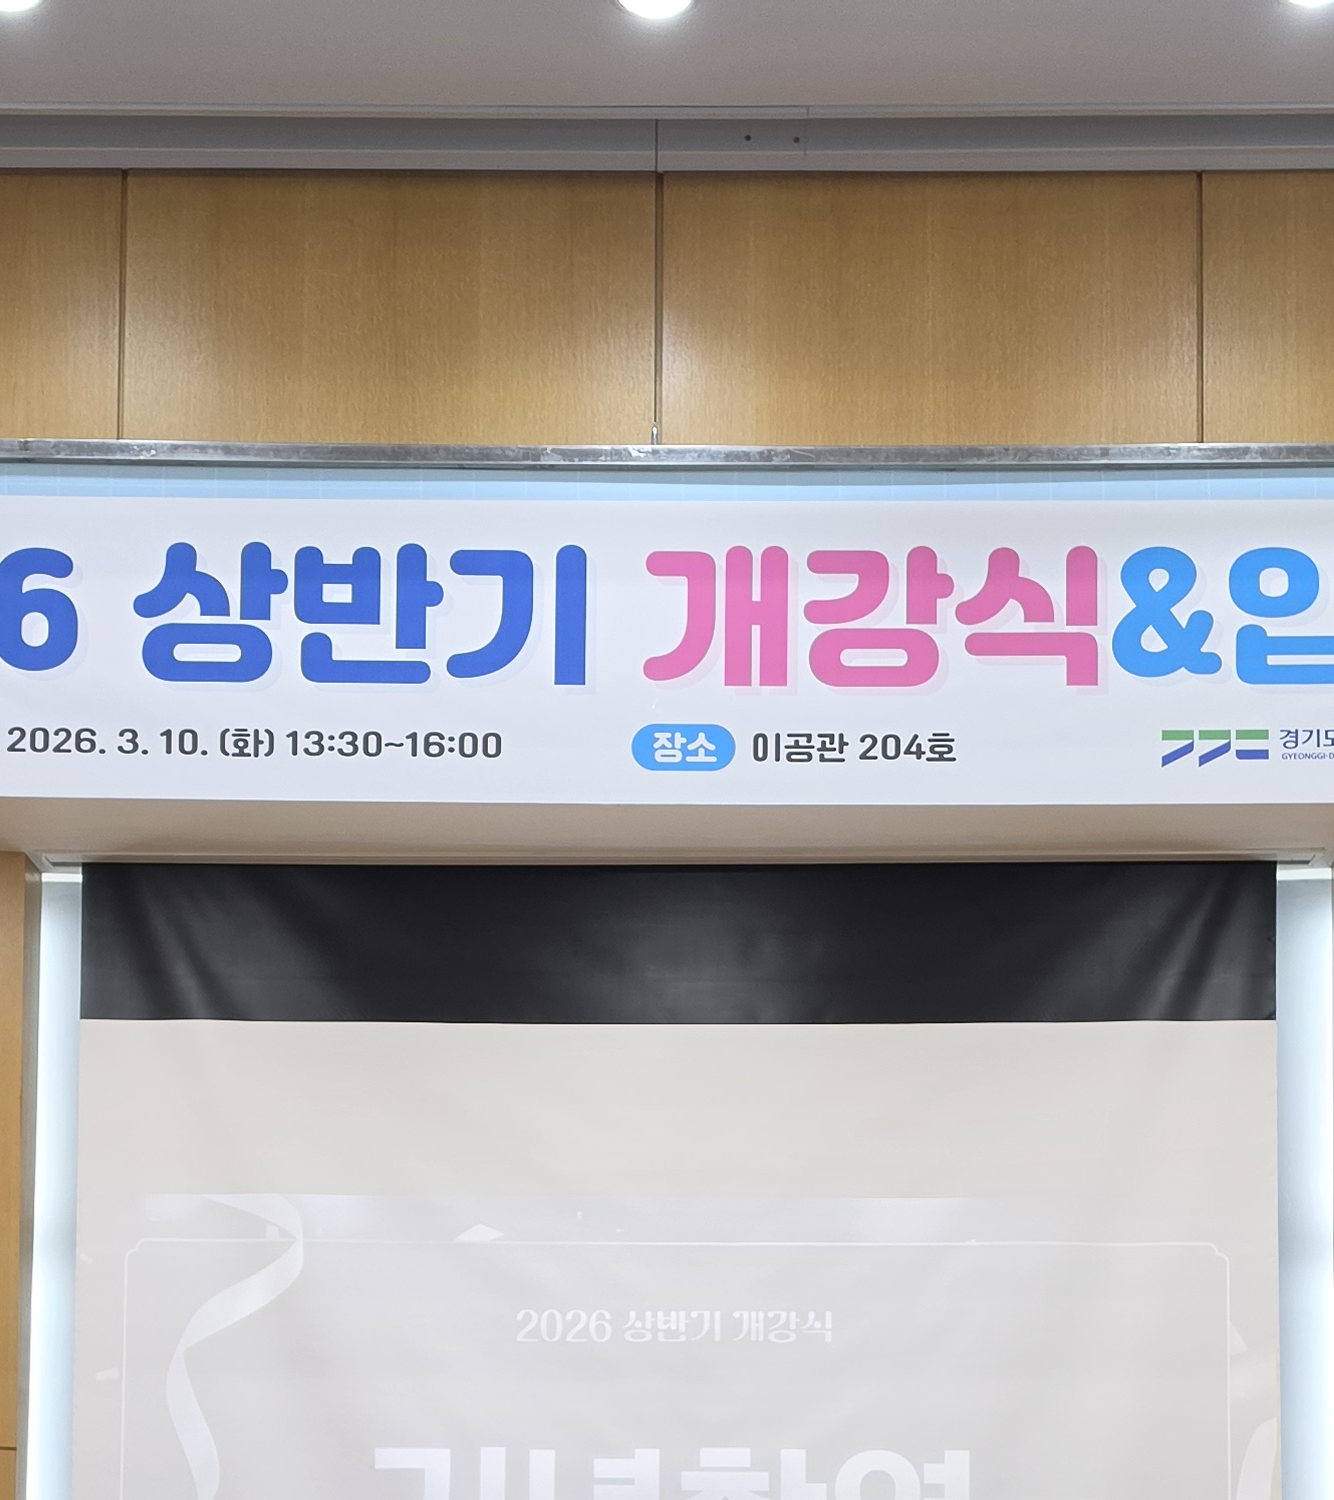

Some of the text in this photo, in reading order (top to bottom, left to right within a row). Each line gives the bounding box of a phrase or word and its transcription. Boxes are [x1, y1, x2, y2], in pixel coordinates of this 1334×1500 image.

[133, 541, 588, 686] 상반기
[5, 726, 503, 760] 2026. 3. 10. (화) 13:30~16:00
[652, 731, 718, 763] 장소
[752, 731, 958, 764] 이공관 204호
[515, 1308, 834, 1344] 2026 상반기 개강식
